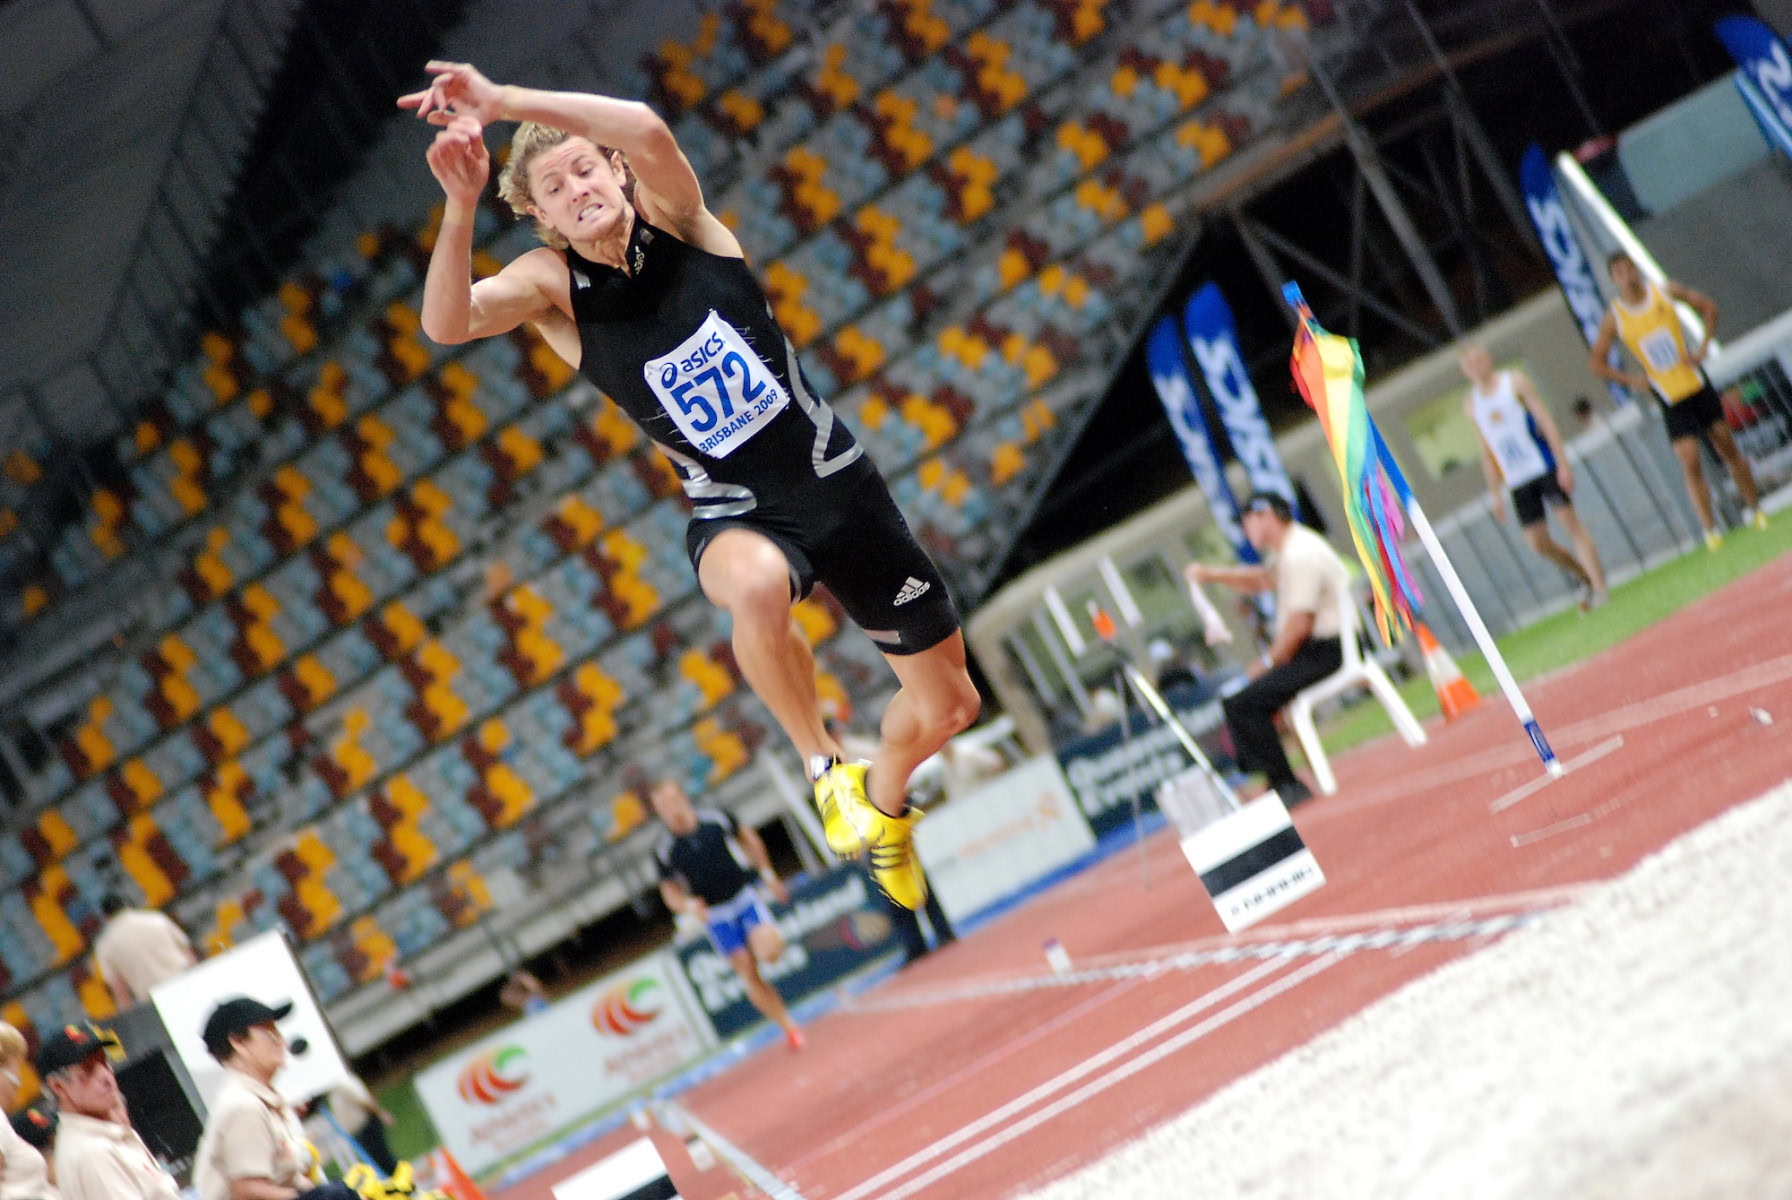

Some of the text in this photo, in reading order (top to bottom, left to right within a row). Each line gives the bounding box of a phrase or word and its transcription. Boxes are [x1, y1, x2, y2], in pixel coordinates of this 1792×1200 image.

[670, 351, 767, 433] 572
[699, 389, 778, 453] BRISBANE 2009
[893, 581, 931, 606] adidas
